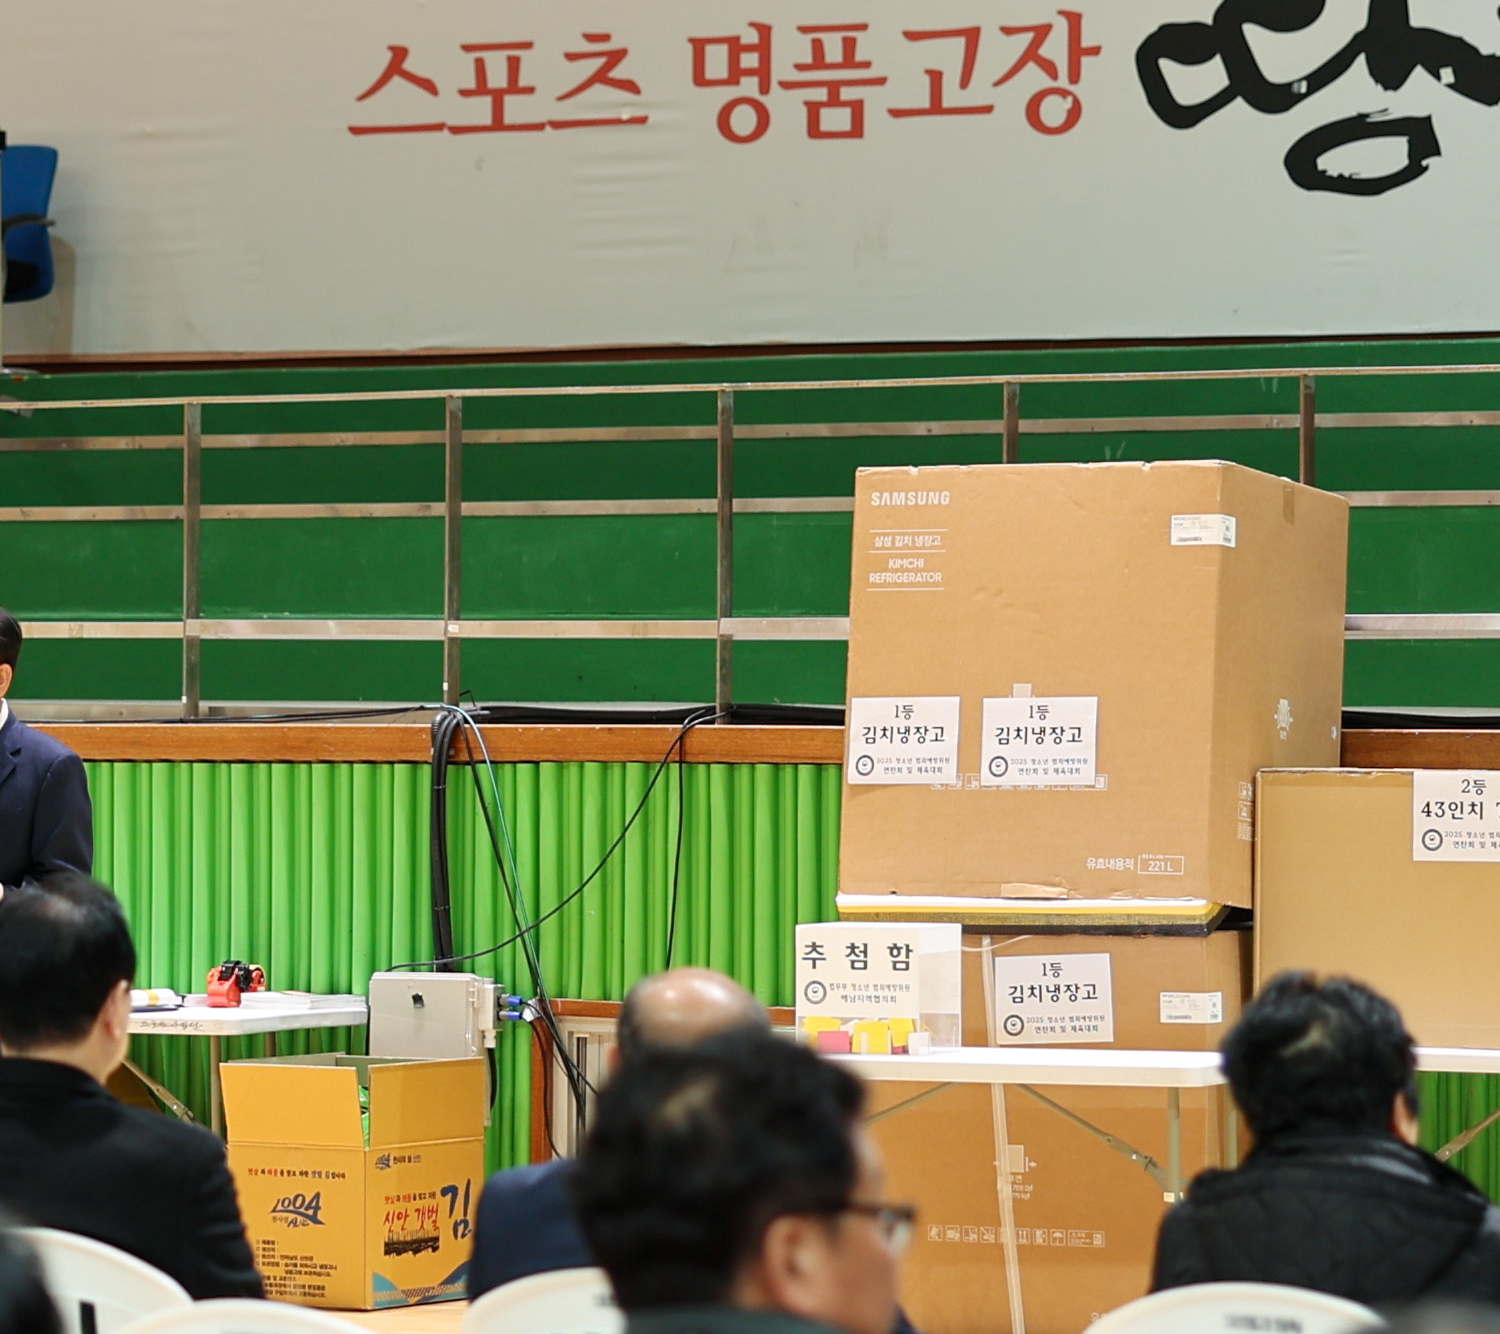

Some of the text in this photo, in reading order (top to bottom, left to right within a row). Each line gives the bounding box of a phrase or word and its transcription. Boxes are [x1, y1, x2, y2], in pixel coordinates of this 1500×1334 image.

[347, 8, 1102, 146] 스포츠 명품고장
[871, 490, 950, 507] SAMSUNG
[874, 535, 941, 547] 삼성 김치 냉장고
[888, 558, 924, 569] KIMCHI
[869, 572, 942, 584] REFRIGERATOR
[894, 704, 915, 721] 1등
[1028, 705, 1050, 721] 1등
[862, 726, 946, 745] 김치냉장고
[995, 726, 1083, 745] 김치냉장고
[1460, 779, 1487, 796] 2등
[1421, 801, 1484, 820] 43인치
[1149, 861, 1165, 872] 221
[1167, 861, 1173, 872] L
[1041, 962, 1063, 978] 1등
[1008, 983, 1098, 1004] 김치냉장고
[440, 1177, 473, 1241] 김
[383, 1203, 440, 1233] 신안 갯벌
